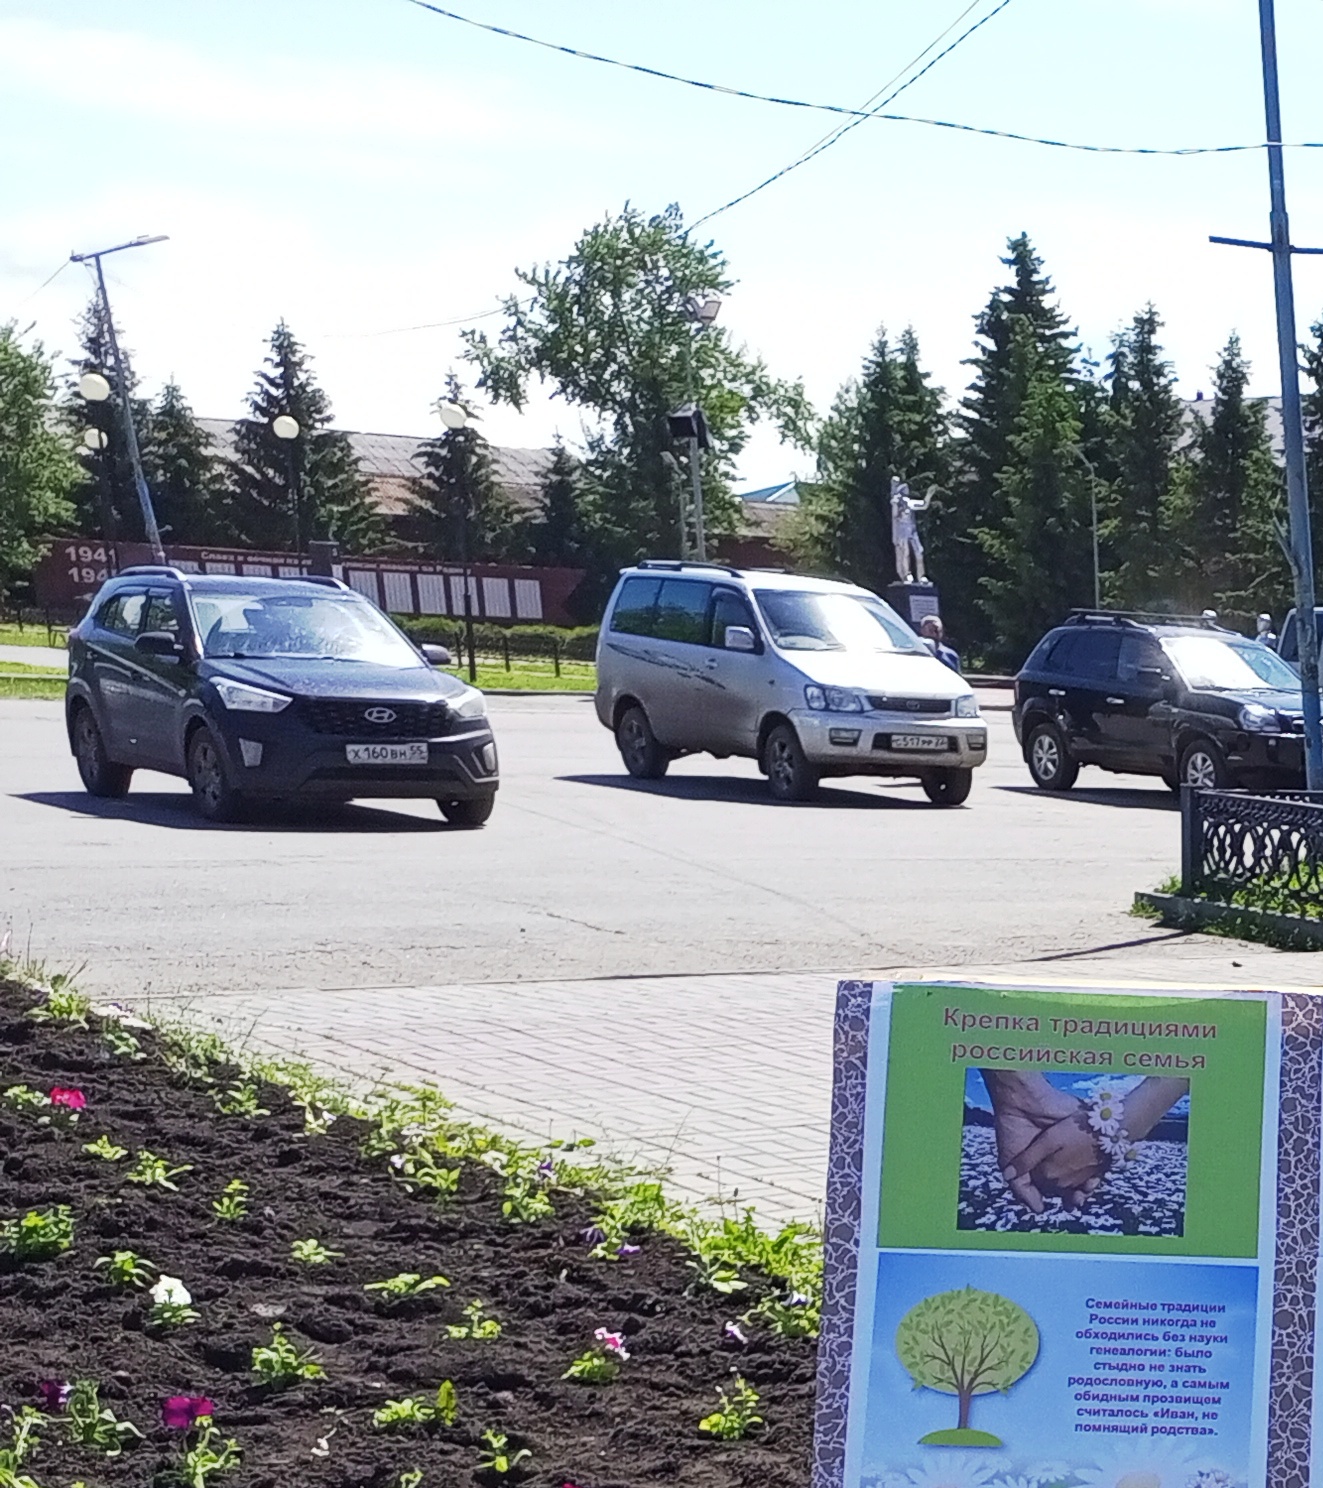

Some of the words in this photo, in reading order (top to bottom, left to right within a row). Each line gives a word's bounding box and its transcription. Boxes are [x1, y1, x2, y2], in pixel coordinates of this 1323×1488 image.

[65, 546, 116, 563] 1941
[944, 1007, 1039, 1031] Крепка
[1051, 1019, 1216, 1039] традициями
[952, 1043, 1112, 1066] российская
[1124, 1053, 1206, 1069] семья
[1086, 1298, 1157, 1311] Семейные
[1161, 1302, 1225, 1313] традиции
